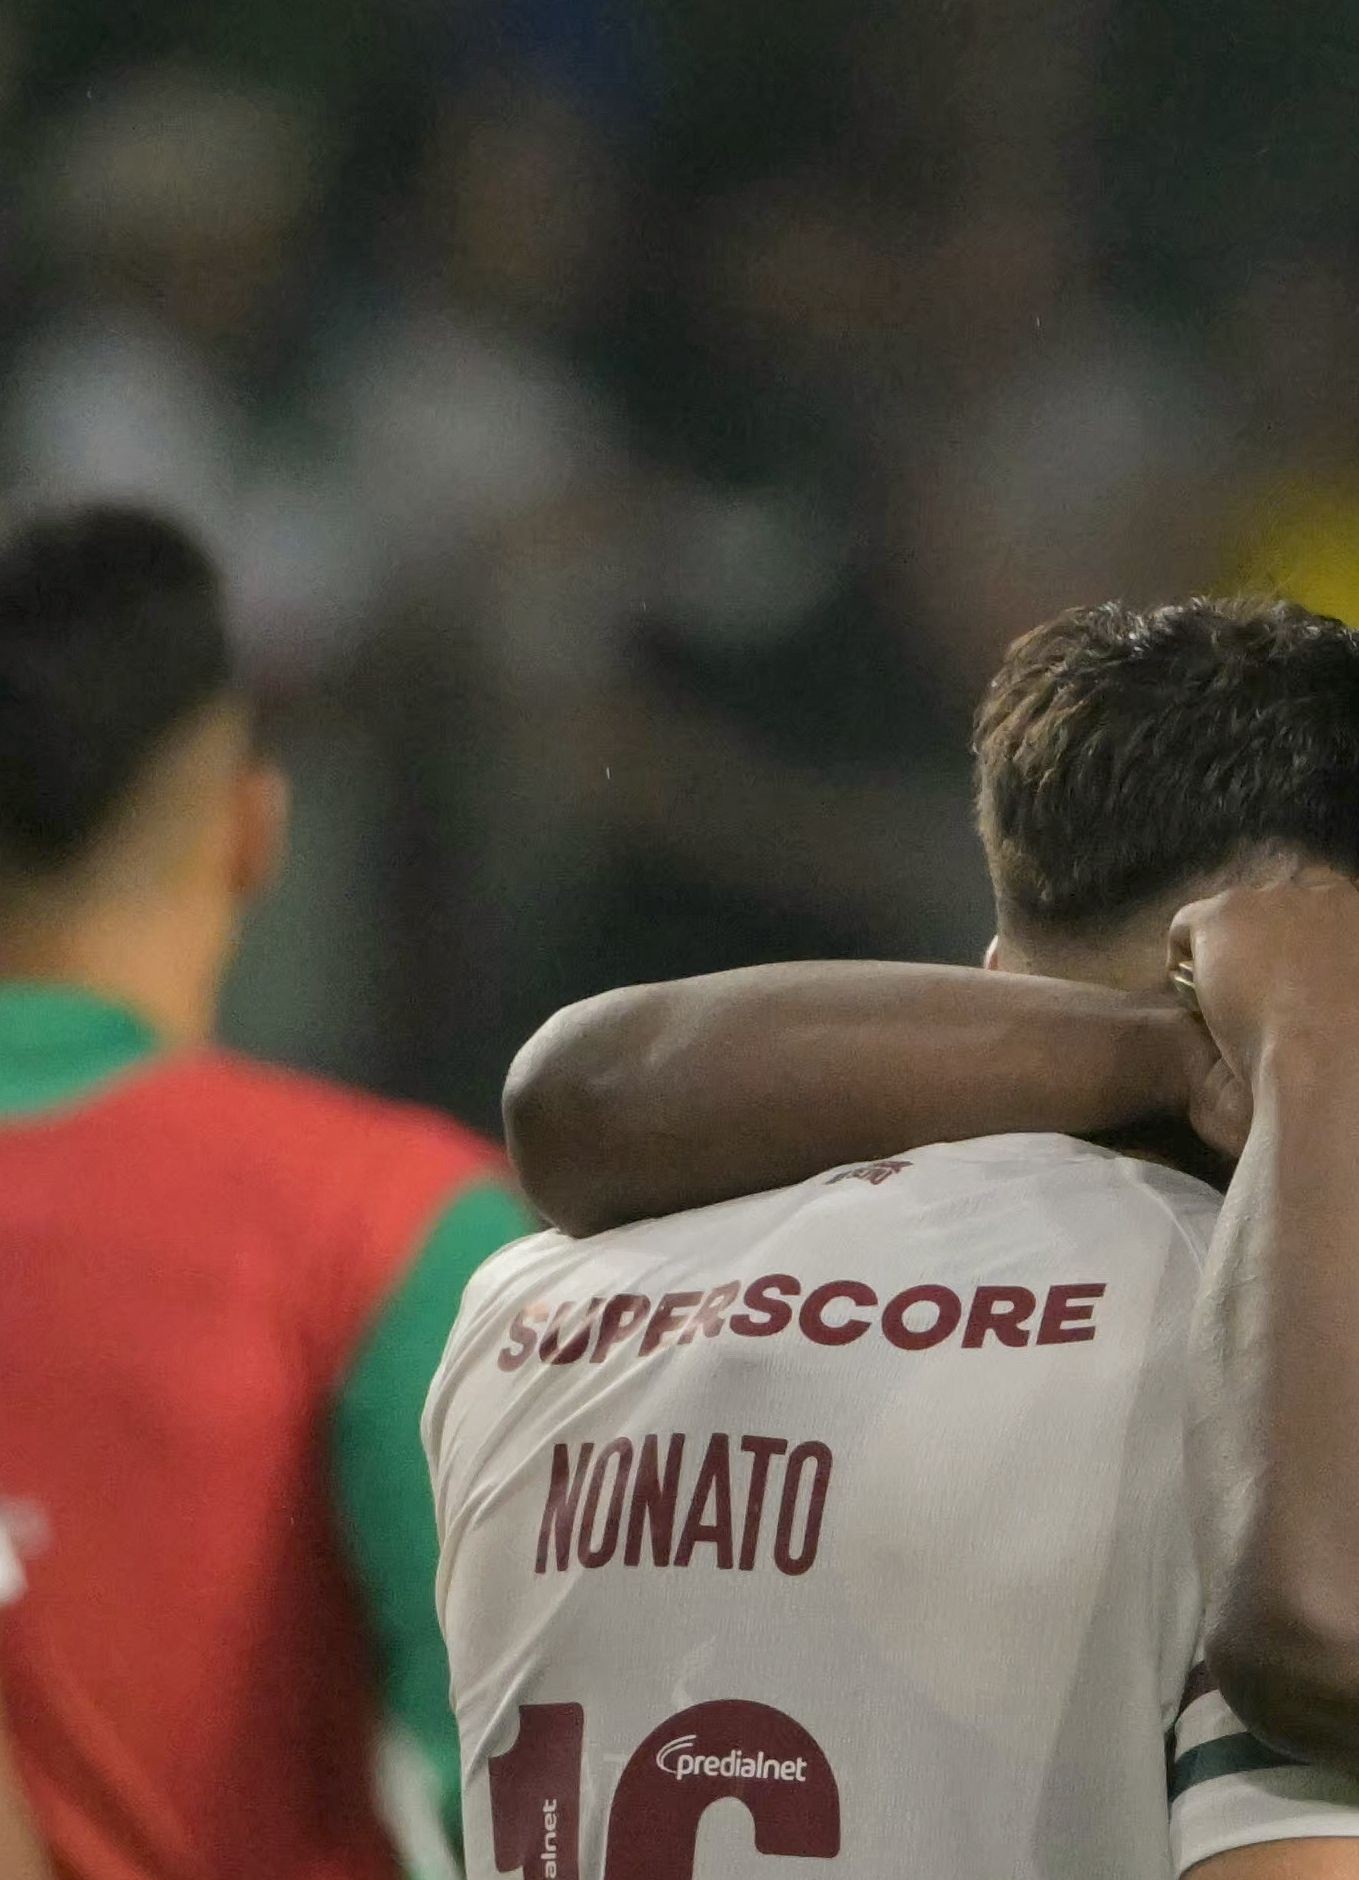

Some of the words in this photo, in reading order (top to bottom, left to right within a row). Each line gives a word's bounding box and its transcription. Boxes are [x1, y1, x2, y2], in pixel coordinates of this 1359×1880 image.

[497, 1272, 1107, 1373] SUPERSCORE
[534, 1432, 834, 1577] NONATO
[676, 1748, 807, 1782] predialnet
